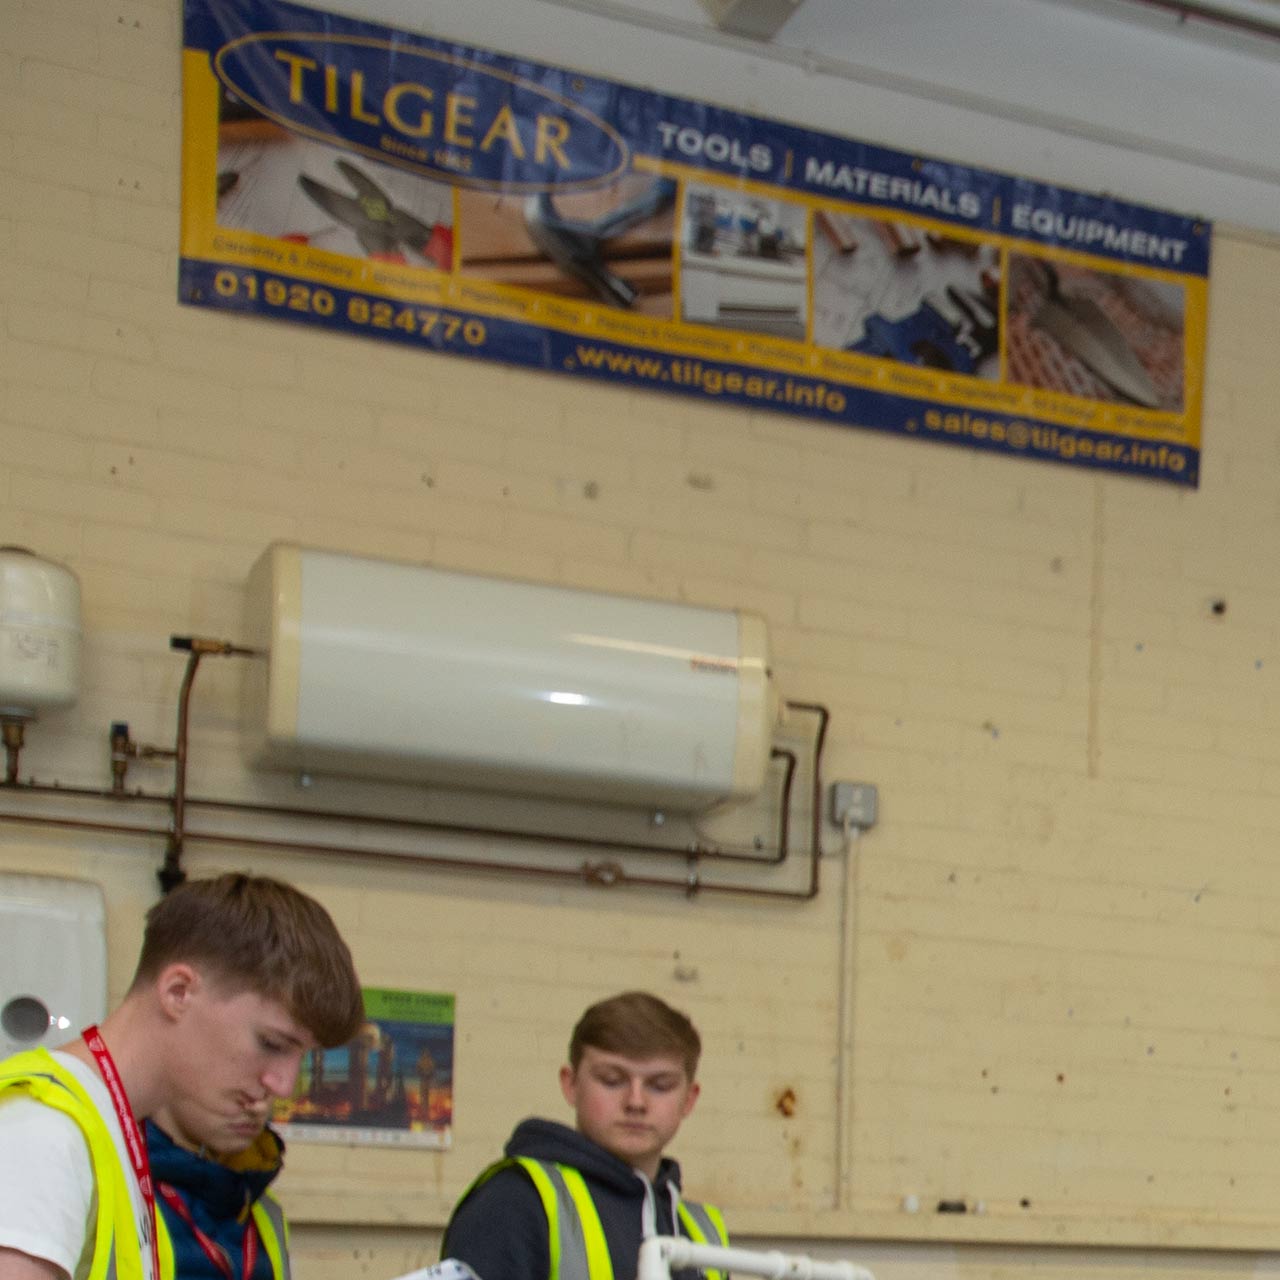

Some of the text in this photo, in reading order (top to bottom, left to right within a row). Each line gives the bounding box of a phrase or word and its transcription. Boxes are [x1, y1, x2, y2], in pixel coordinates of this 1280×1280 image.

[274, 49, 572, 170] TILGEAR
[657, 121, 1187, 262] TOOLS MATERIALS EQUIPMENT
[213, 270, 336, 316] 01920
[347, 297, 487, 346] 824770
[576, 345, 846, 413] www.tilgear.info
[924, 409, 1186, 472] sales@tilgear.info
